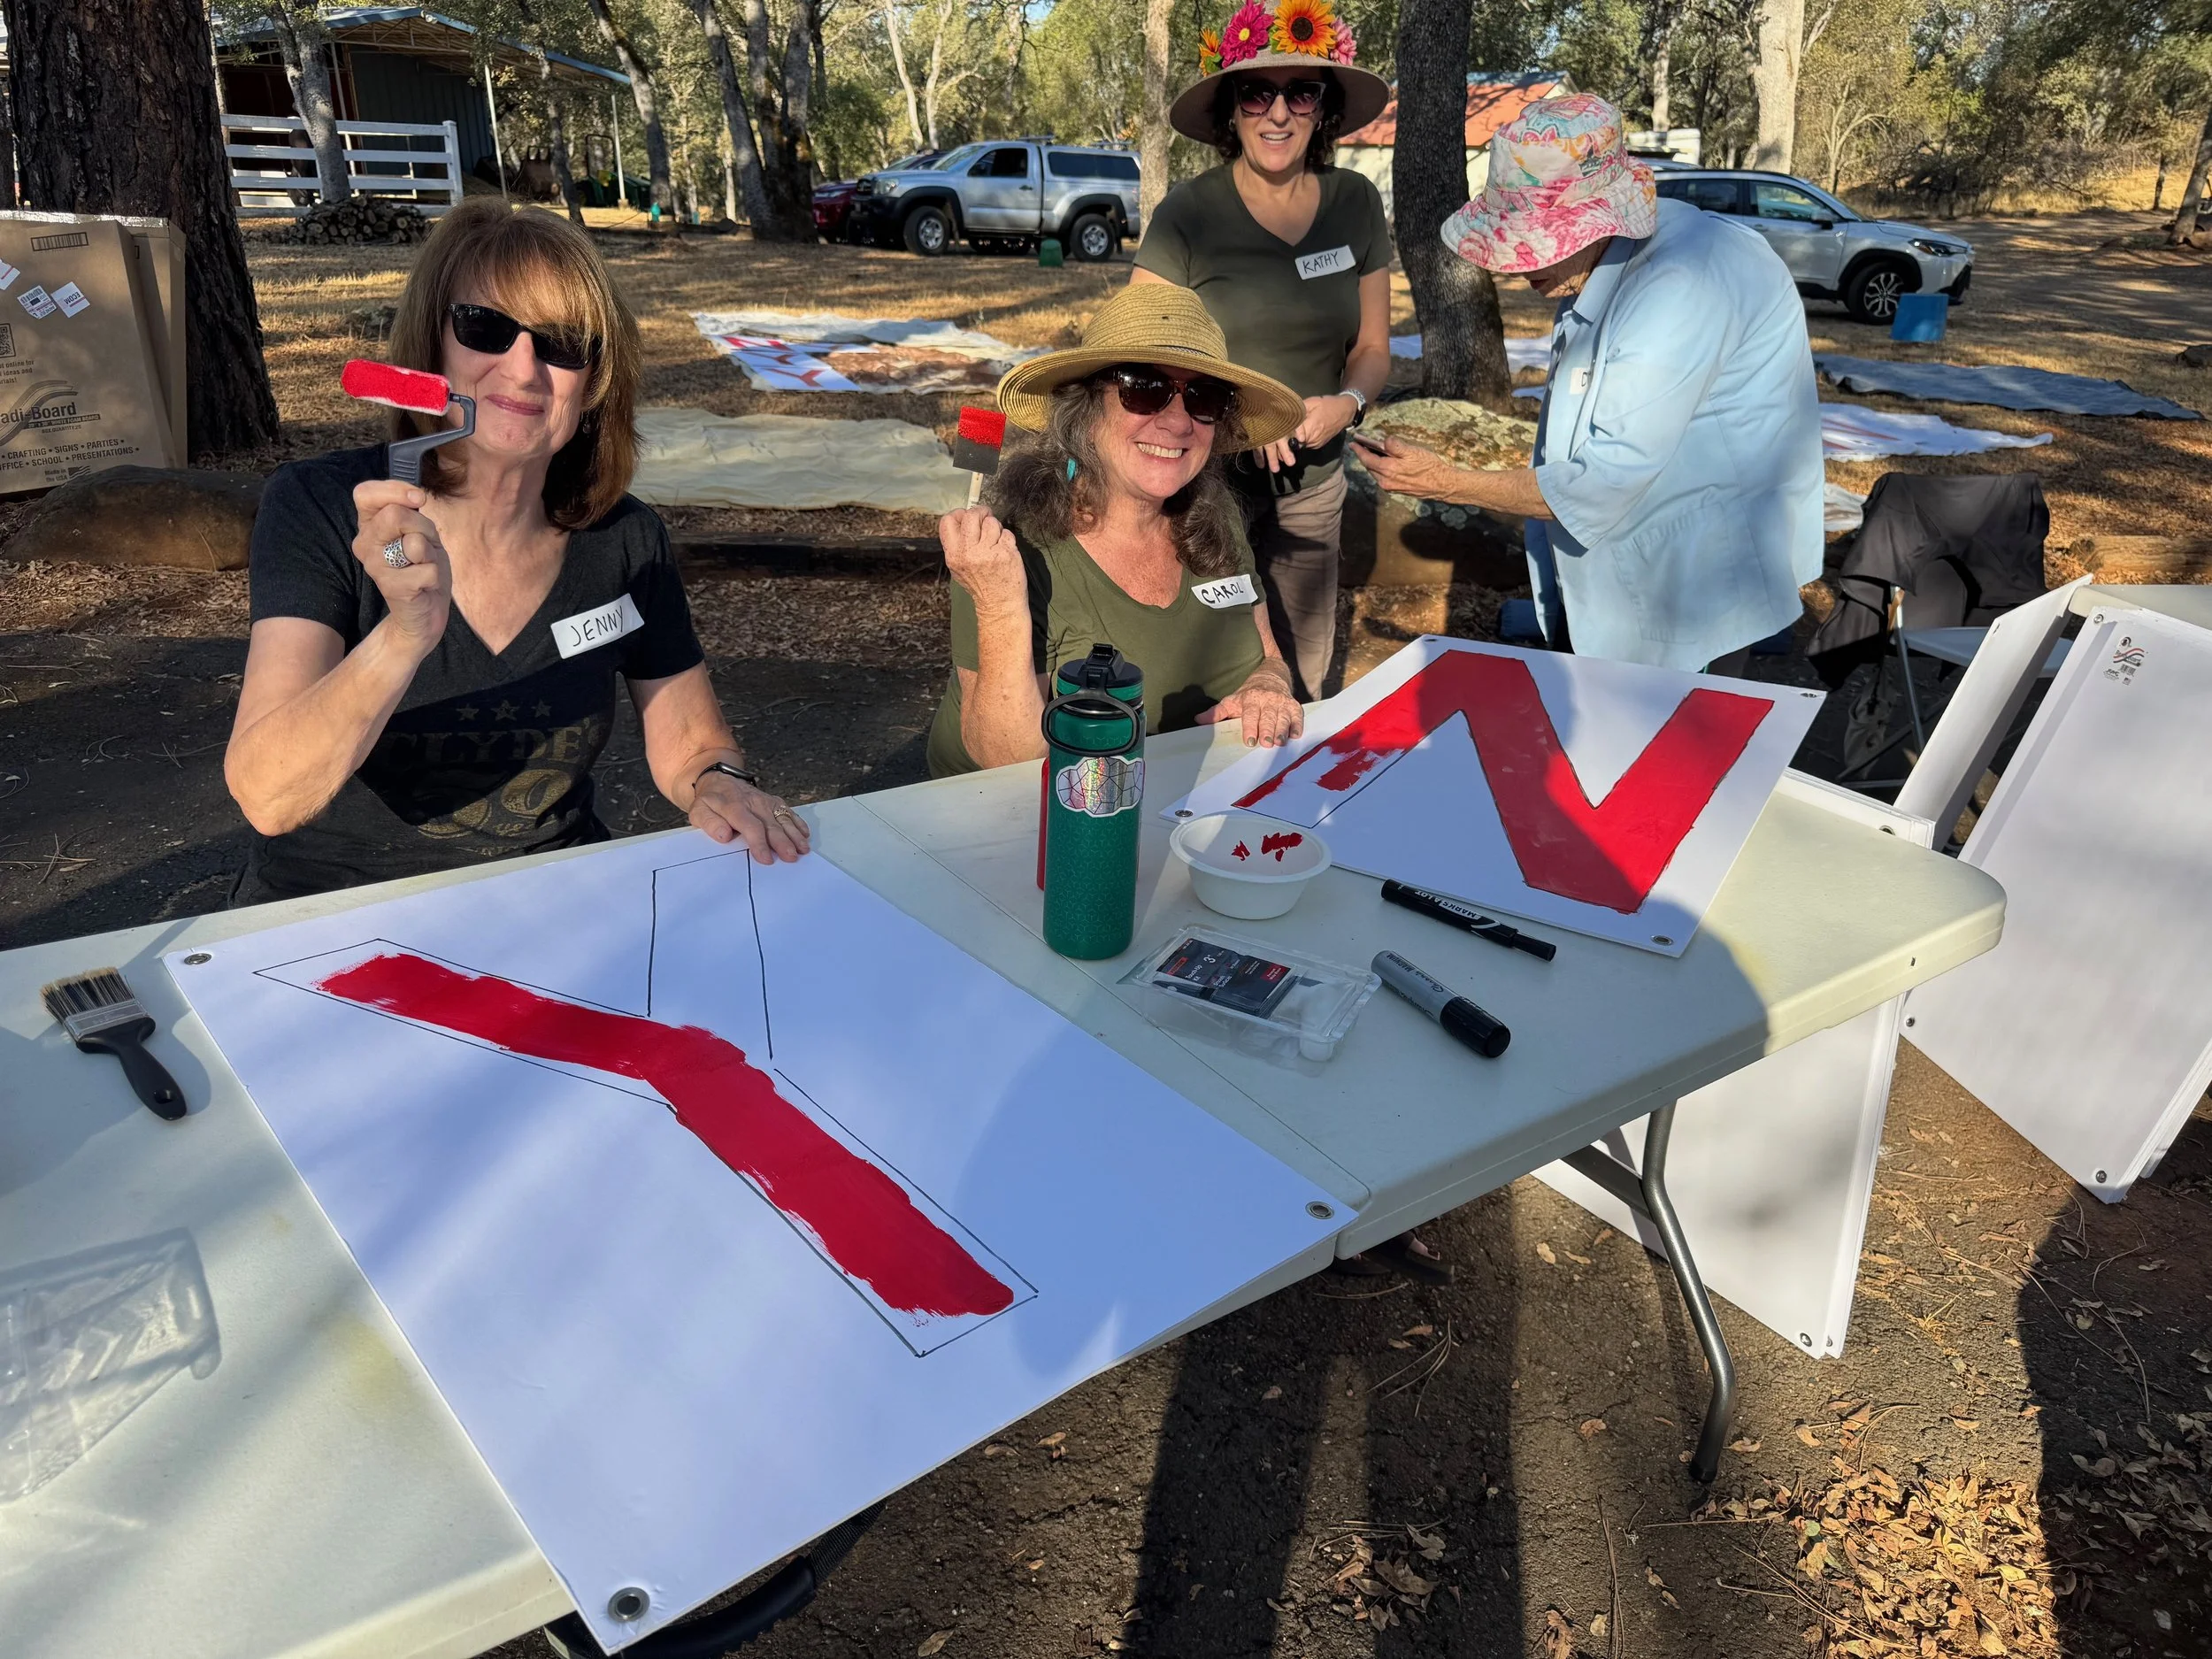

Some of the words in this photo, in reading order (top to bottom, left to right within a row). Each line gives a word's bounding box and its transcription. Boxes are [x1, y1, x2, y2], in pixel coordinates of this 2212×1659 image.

[1302, 251, 1339, 273] KATHY
[64, 292, 81, 304] ECOM
[7, 449, 47, 459] CRAFTING
[55, 444, 79, 453] SIGNS
[87, 439, 119, 449] PARTIES
[32, 457, 64, 466] SCHOOL
[72, 447, 134, 461] PRESENTATIONS
[1202, 582, 1244, 603] CAROL
[571, 605, 623, 647] JENNY
[1442, 902, 1477, 918] MARKS
